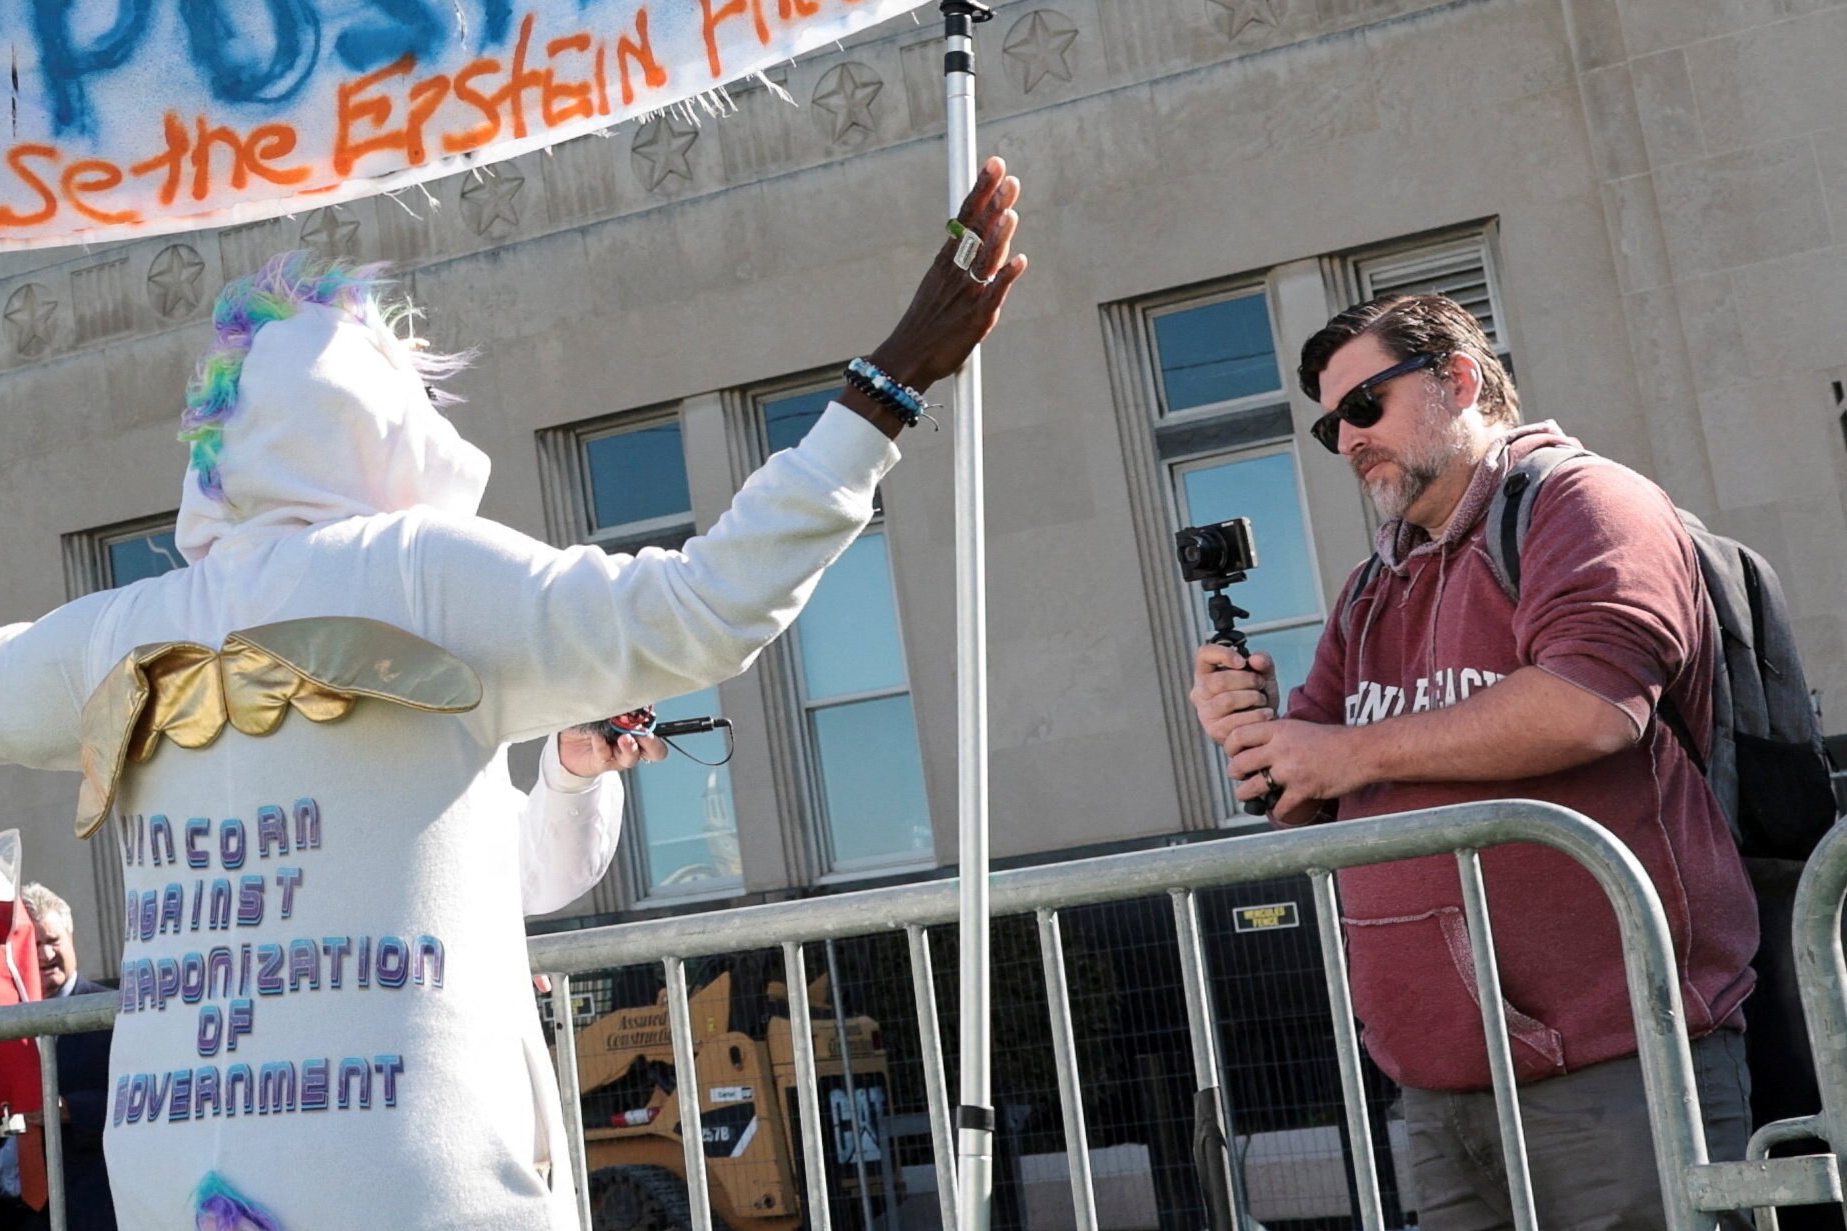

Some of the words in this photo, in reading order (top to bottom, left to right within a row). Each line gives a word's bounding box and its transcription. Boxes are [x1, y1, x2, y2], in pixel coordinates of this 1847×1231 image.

[124, 867, 304, 940] AGAINST
[197, 998, 254, 1057] OF
[113, 1054, 406, 1127] GOVERNMENT
[829, 1086, 887, 1165] CAT
